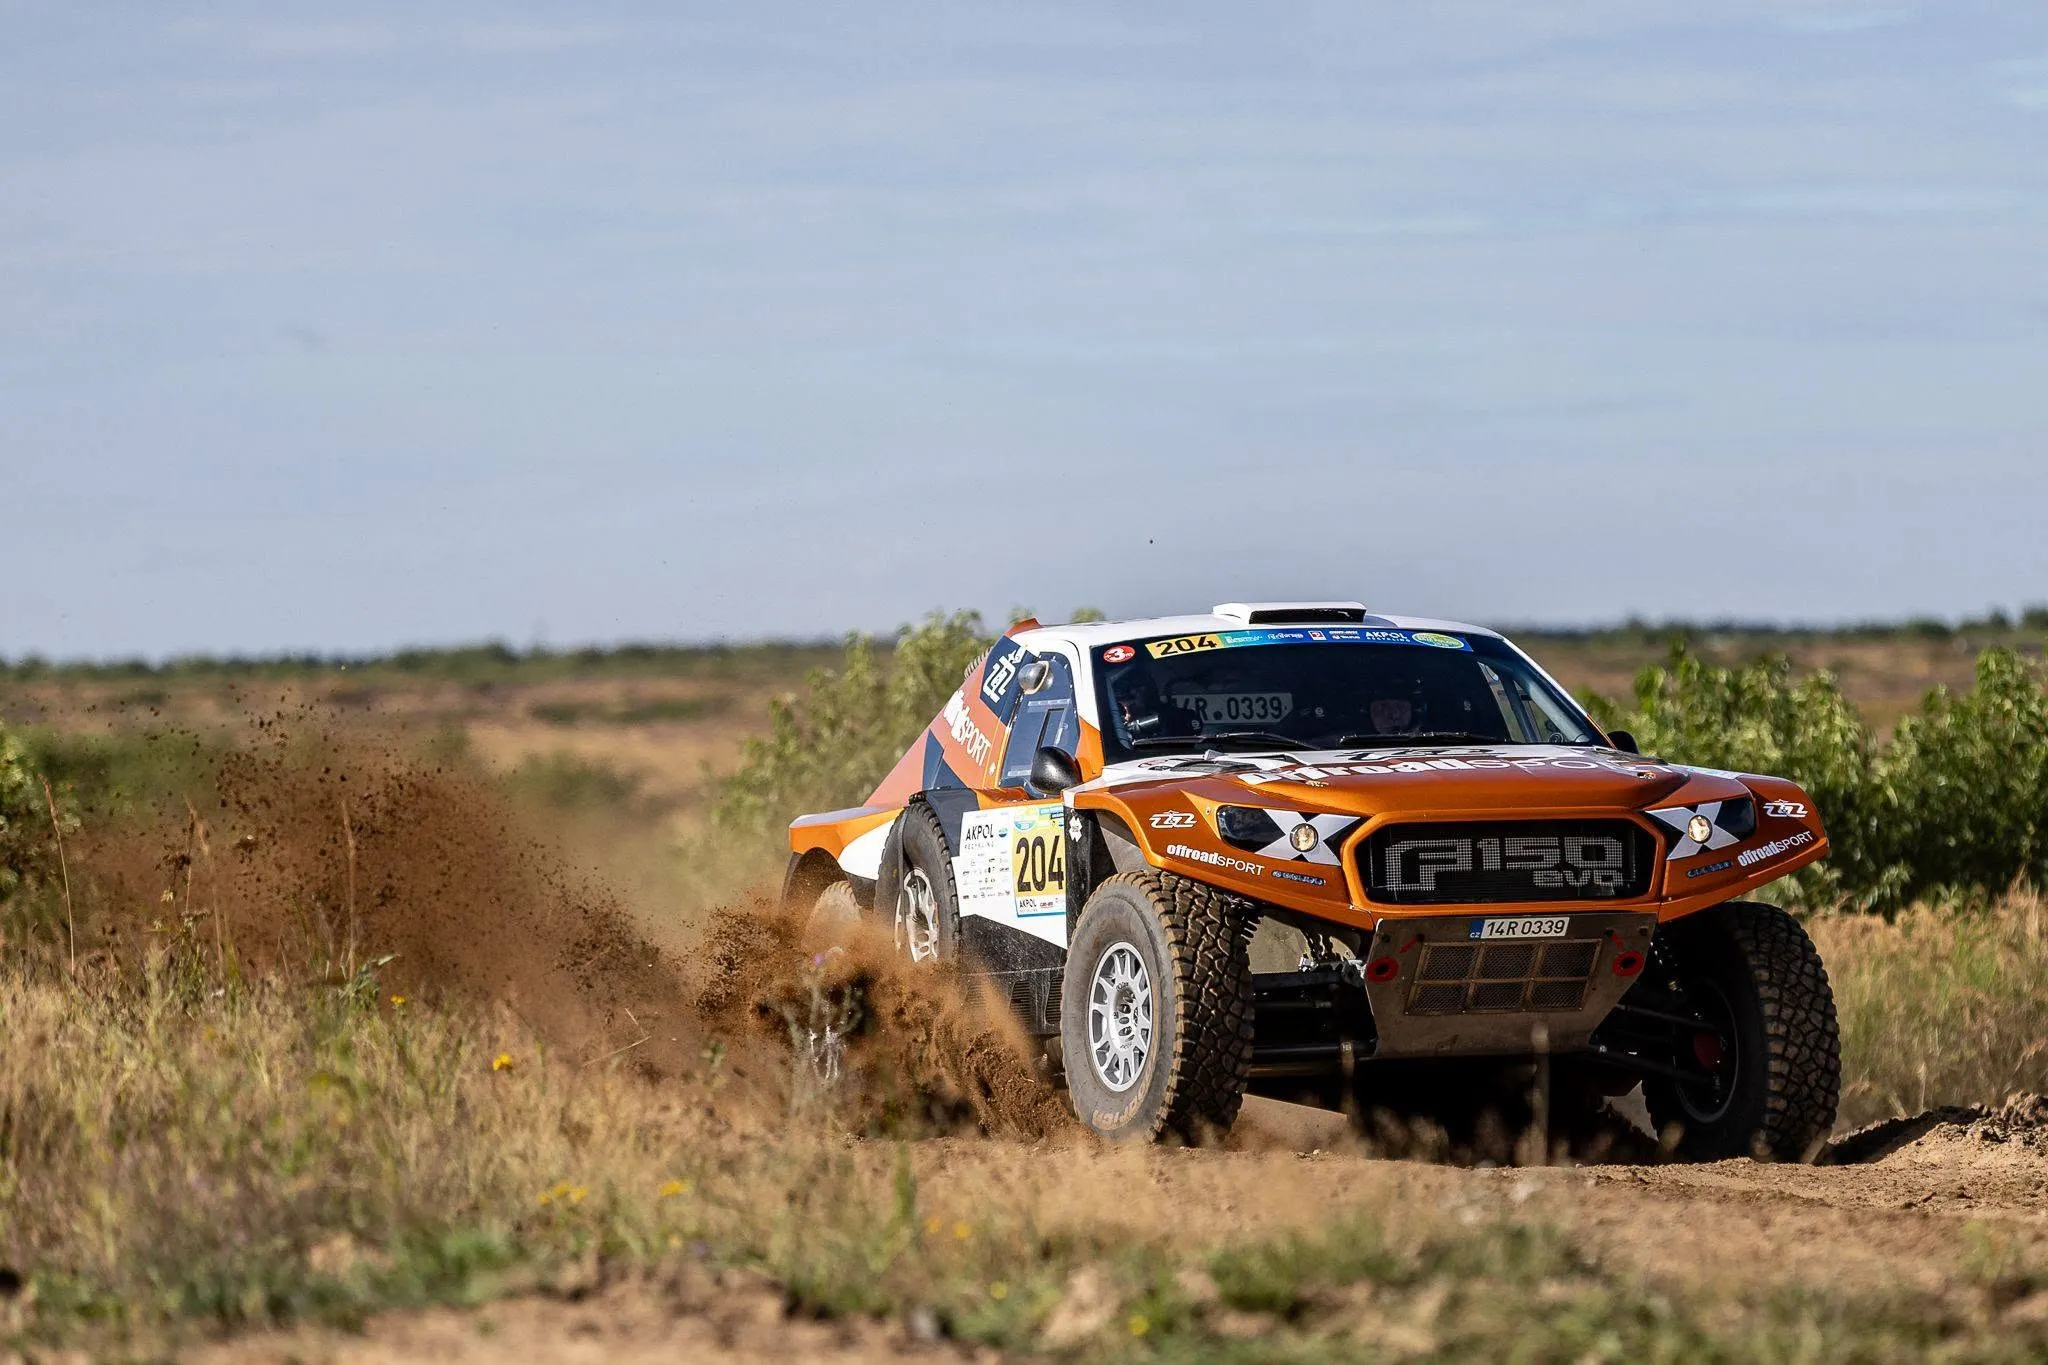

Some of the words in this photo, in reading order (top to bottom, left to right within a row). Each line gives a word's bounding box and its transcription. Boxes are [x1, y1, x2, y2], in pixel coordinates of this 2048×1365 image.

[1155, 636, 1218, 656] 204
[966, 823, 994, 841] AKPOL
[1166, 844, 1265, 876] offroadSPORT
[1737, 830, 1814, 867] offroadSPORT
[1016, 835, 1064, 892] 204
[1486, 921, 1519, 936] 14R
[1520, 919, 1566, 935] 0339
